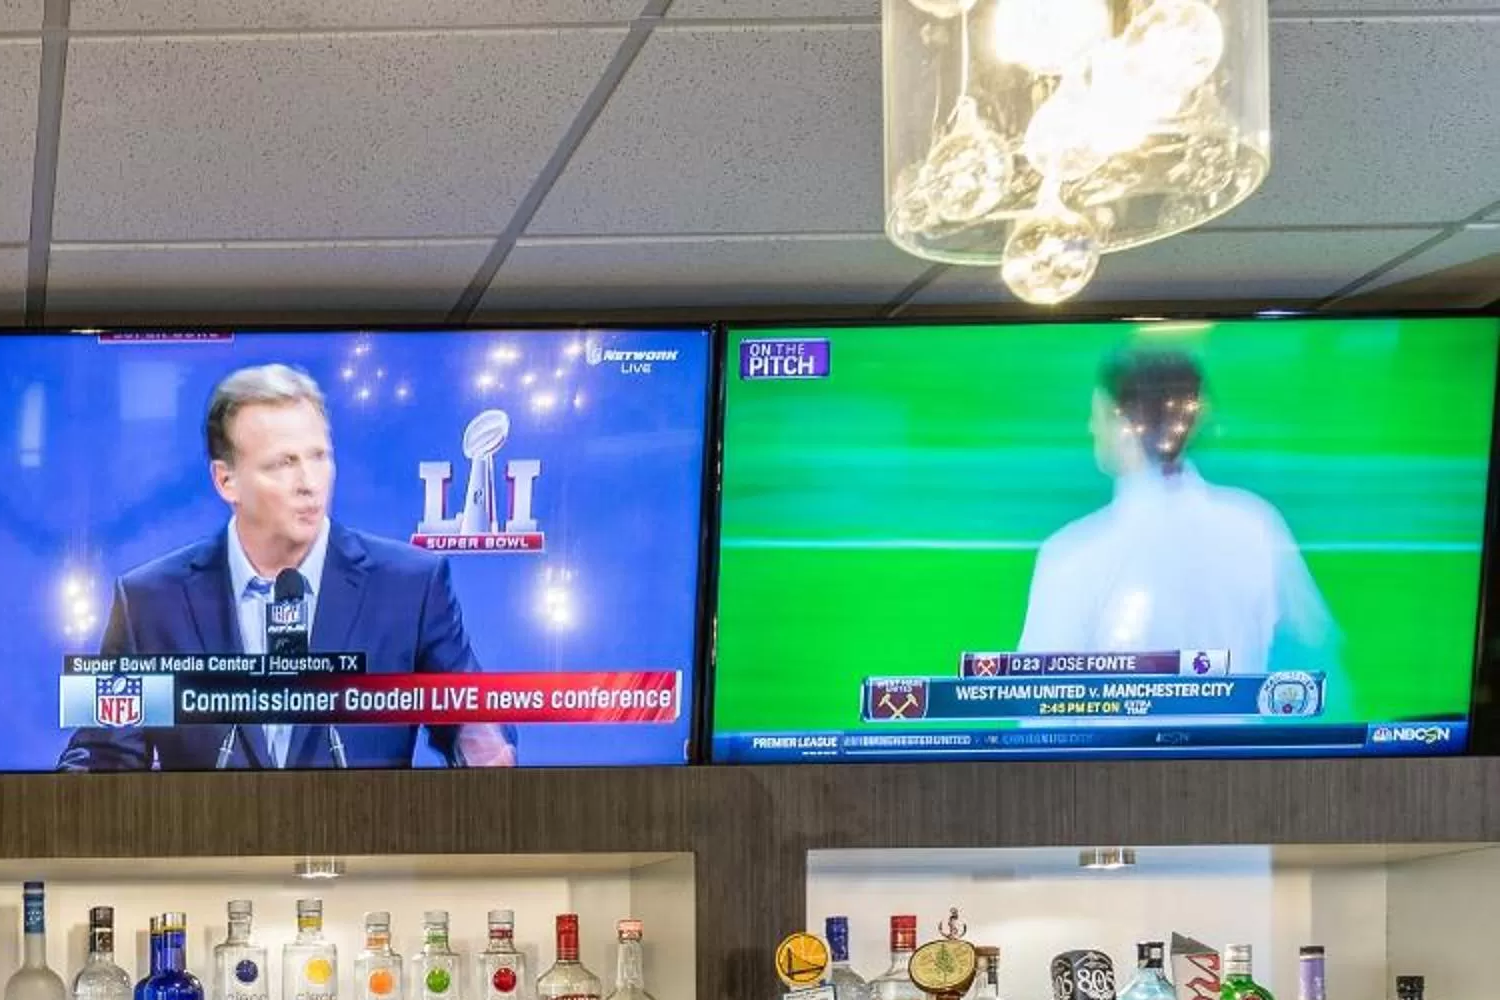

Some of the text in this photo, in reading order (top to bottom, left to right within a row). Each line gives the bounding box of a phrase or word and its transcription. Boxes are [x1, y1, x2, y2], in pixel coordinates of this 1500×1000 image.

[749, 343, 805, 355] ON THE
[621, 363, 652, 374] LIVE
[749, 355, 815, 376] PITCH
[426, 536, 529, 549] SUPER BOWL
[73, 655, 358, 674] Super Bowl Media Center Houston, TX
[1023, 656, 1137, 671] 23 JOSE FONTE
[956, 686, 999, 700] WEST
[999, 686, 1032, 700] HAM
[1033, 685, 1085, 699] UNITED
[1103, 683, 1199, 697] MANCHESTER
[1201, 682, 1234, 697] CITY
[182, 687, 671, 712] Commissioner Goodell LIVE news conference
[1067, 703, 1085, 714] PM
[1086, 702, 1102, 713] ET
[1102, 701, 1120, 713] ON
[99, 697, 139, 724] NFL
[753, 737, 798, 748] PREMIER
[798, 736, 837, 748] LEAGUE
[1077, 969, 1116, 992] 805
